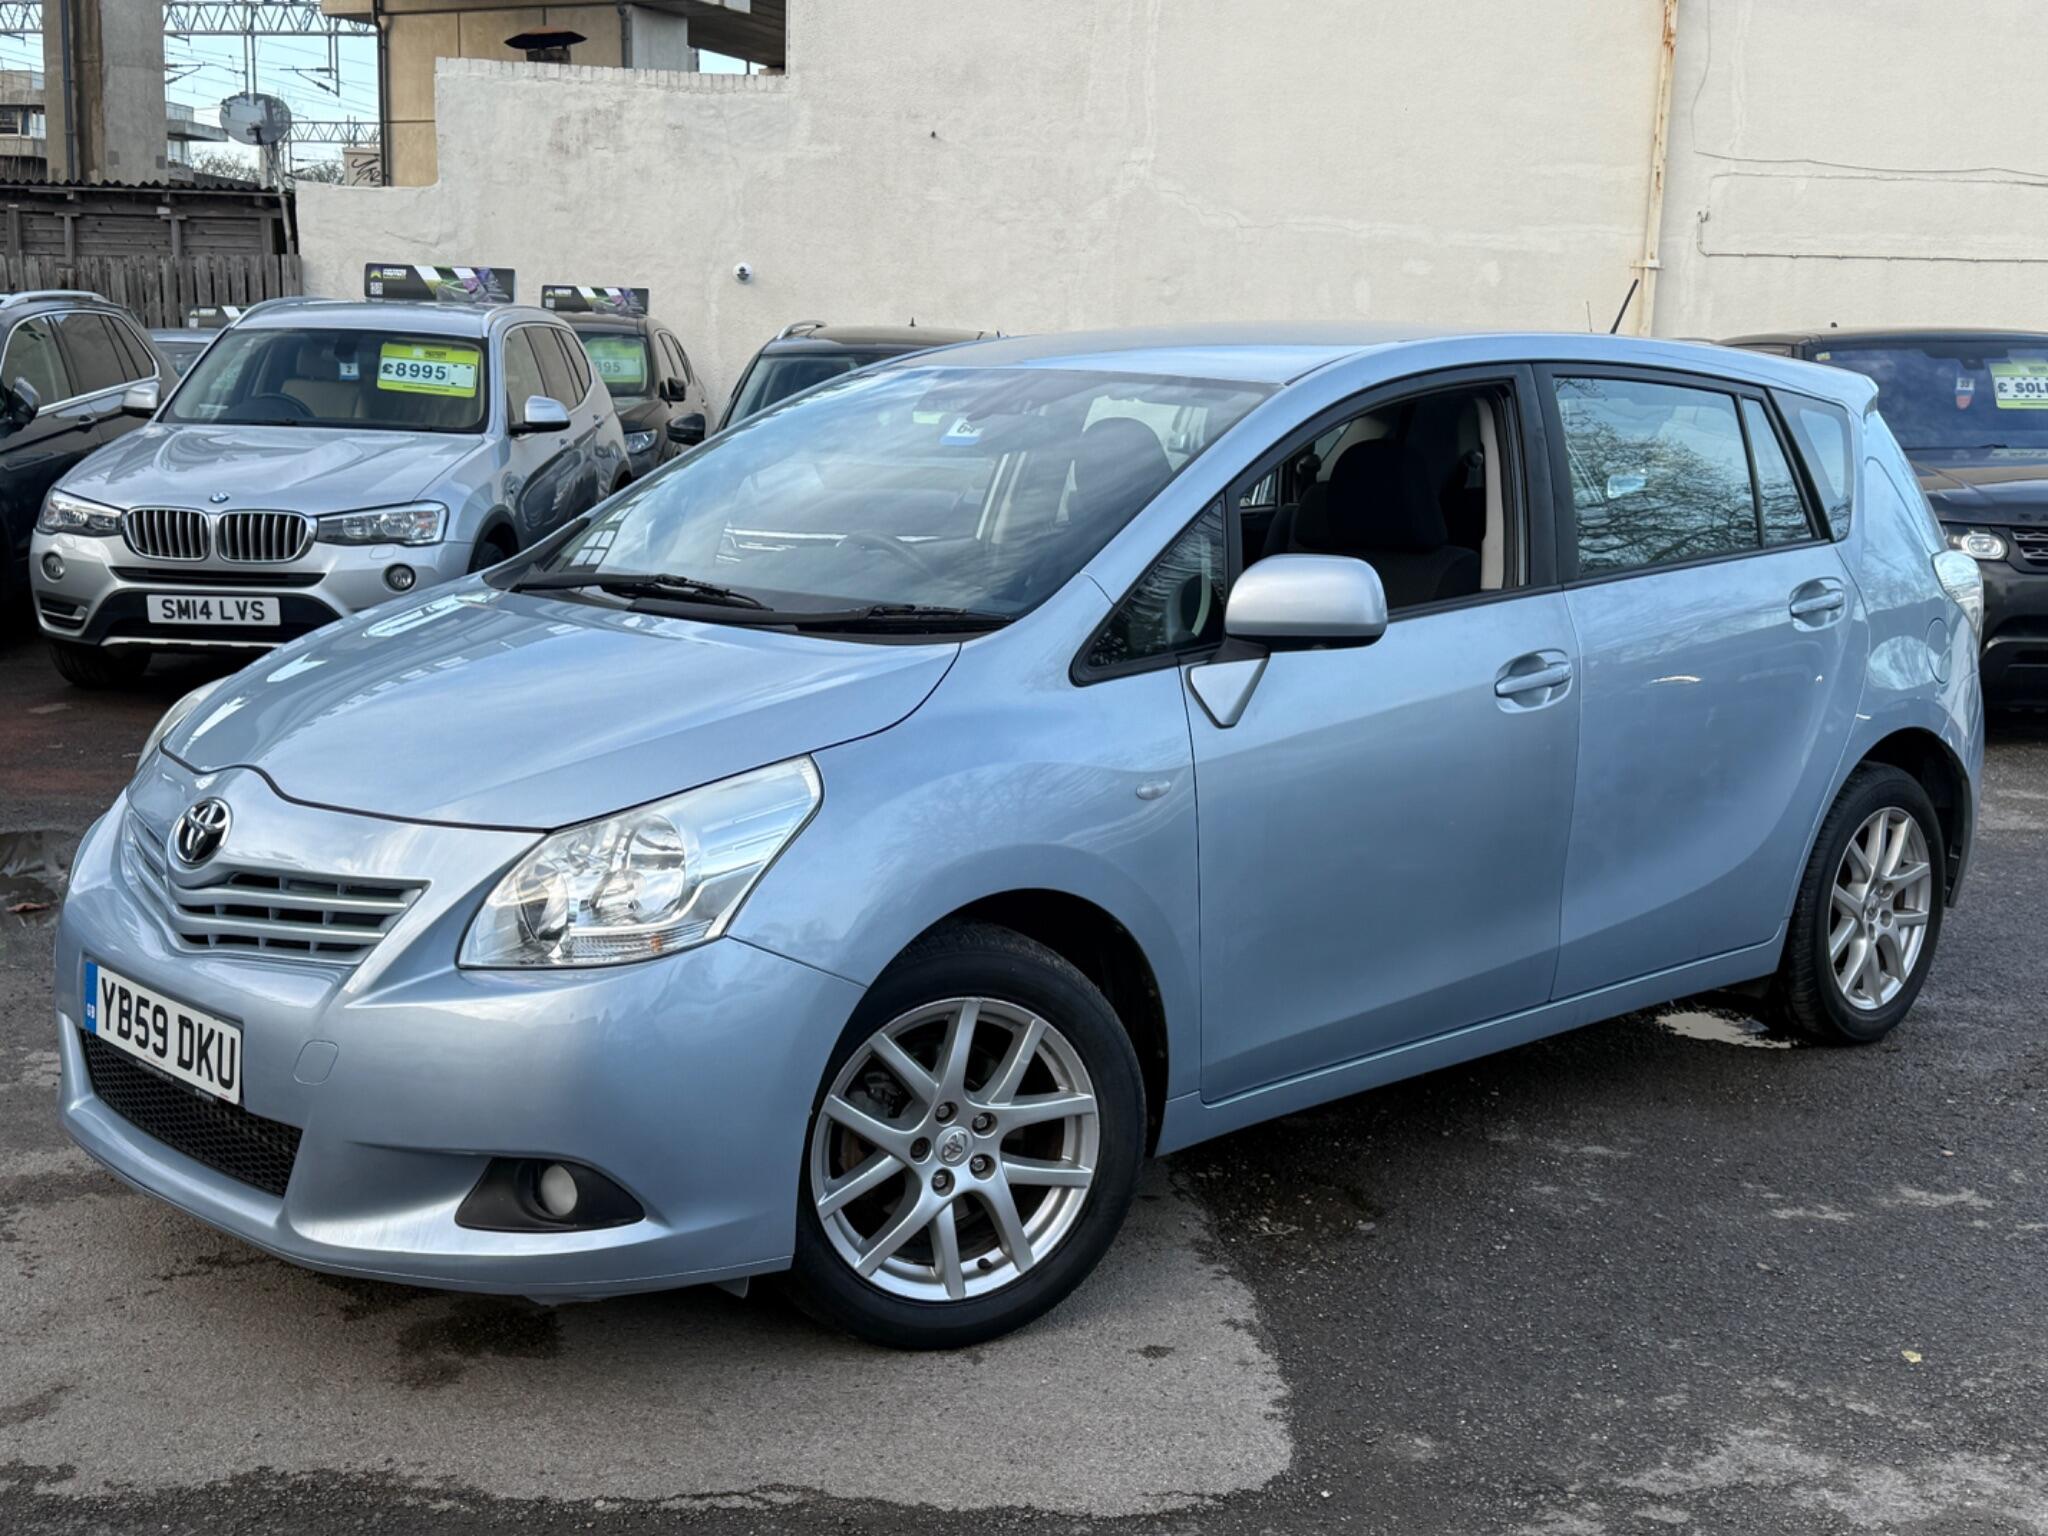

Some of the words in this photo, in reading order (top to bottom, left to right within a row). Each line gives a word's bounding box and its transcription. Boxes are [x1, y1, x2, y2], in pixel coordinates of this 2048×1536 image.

[382, 362, 446, 380] £8995
[161, 599, 213, 620] SM14
[219, 600, 266, 621] LVS
[101, 976, 169, 1059] YB59
[177, 1013, 236, 1090] DKU
